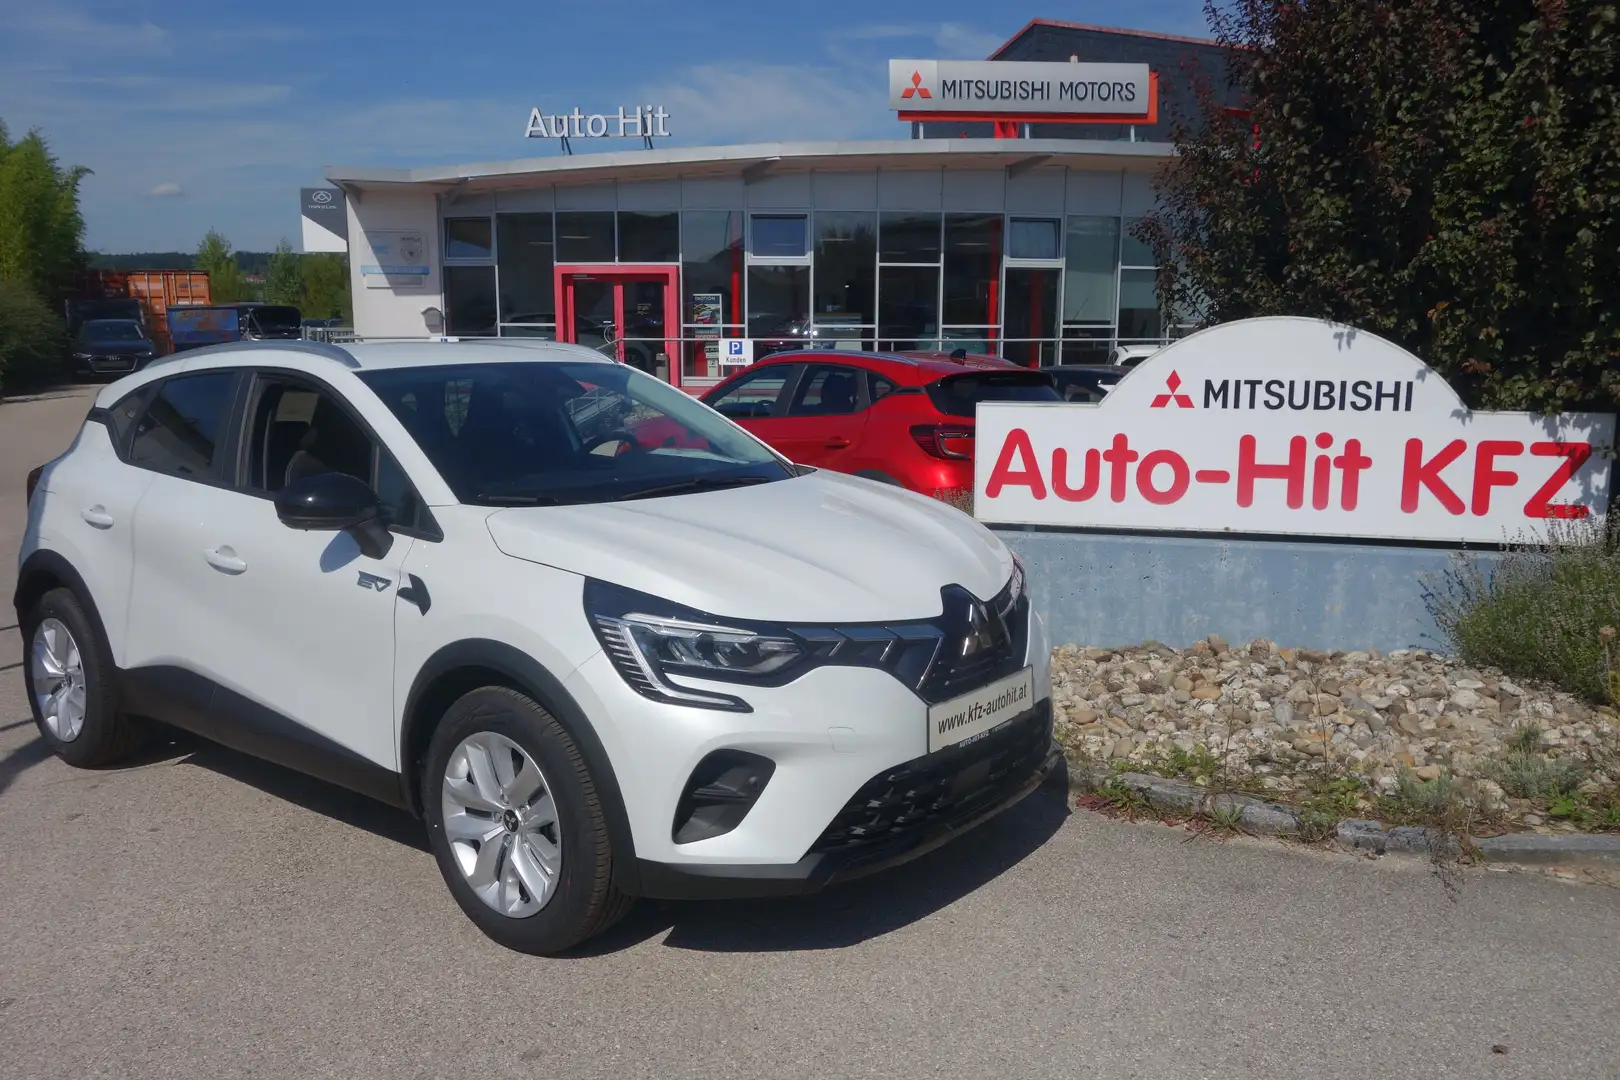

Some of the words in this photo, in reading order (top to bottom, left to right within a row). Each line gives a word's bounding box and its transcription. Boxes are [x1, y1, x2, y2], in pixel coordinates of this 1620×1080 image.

[942, 79, 1050, 100] MITSUBISHI
[1059, 81, 1136, 102] MOTORS
[524, 106, 608, 138] Auto
[618, 104, 671, 137] Hit
[1203, 379, 1414, 412] MITSUBISHI
[985, 428, 1373, 512] Auto-Hit
[1401, 437, 1592, 519] KFZ
[938, 682, 1027, 734] www.kfz-autohit.at
